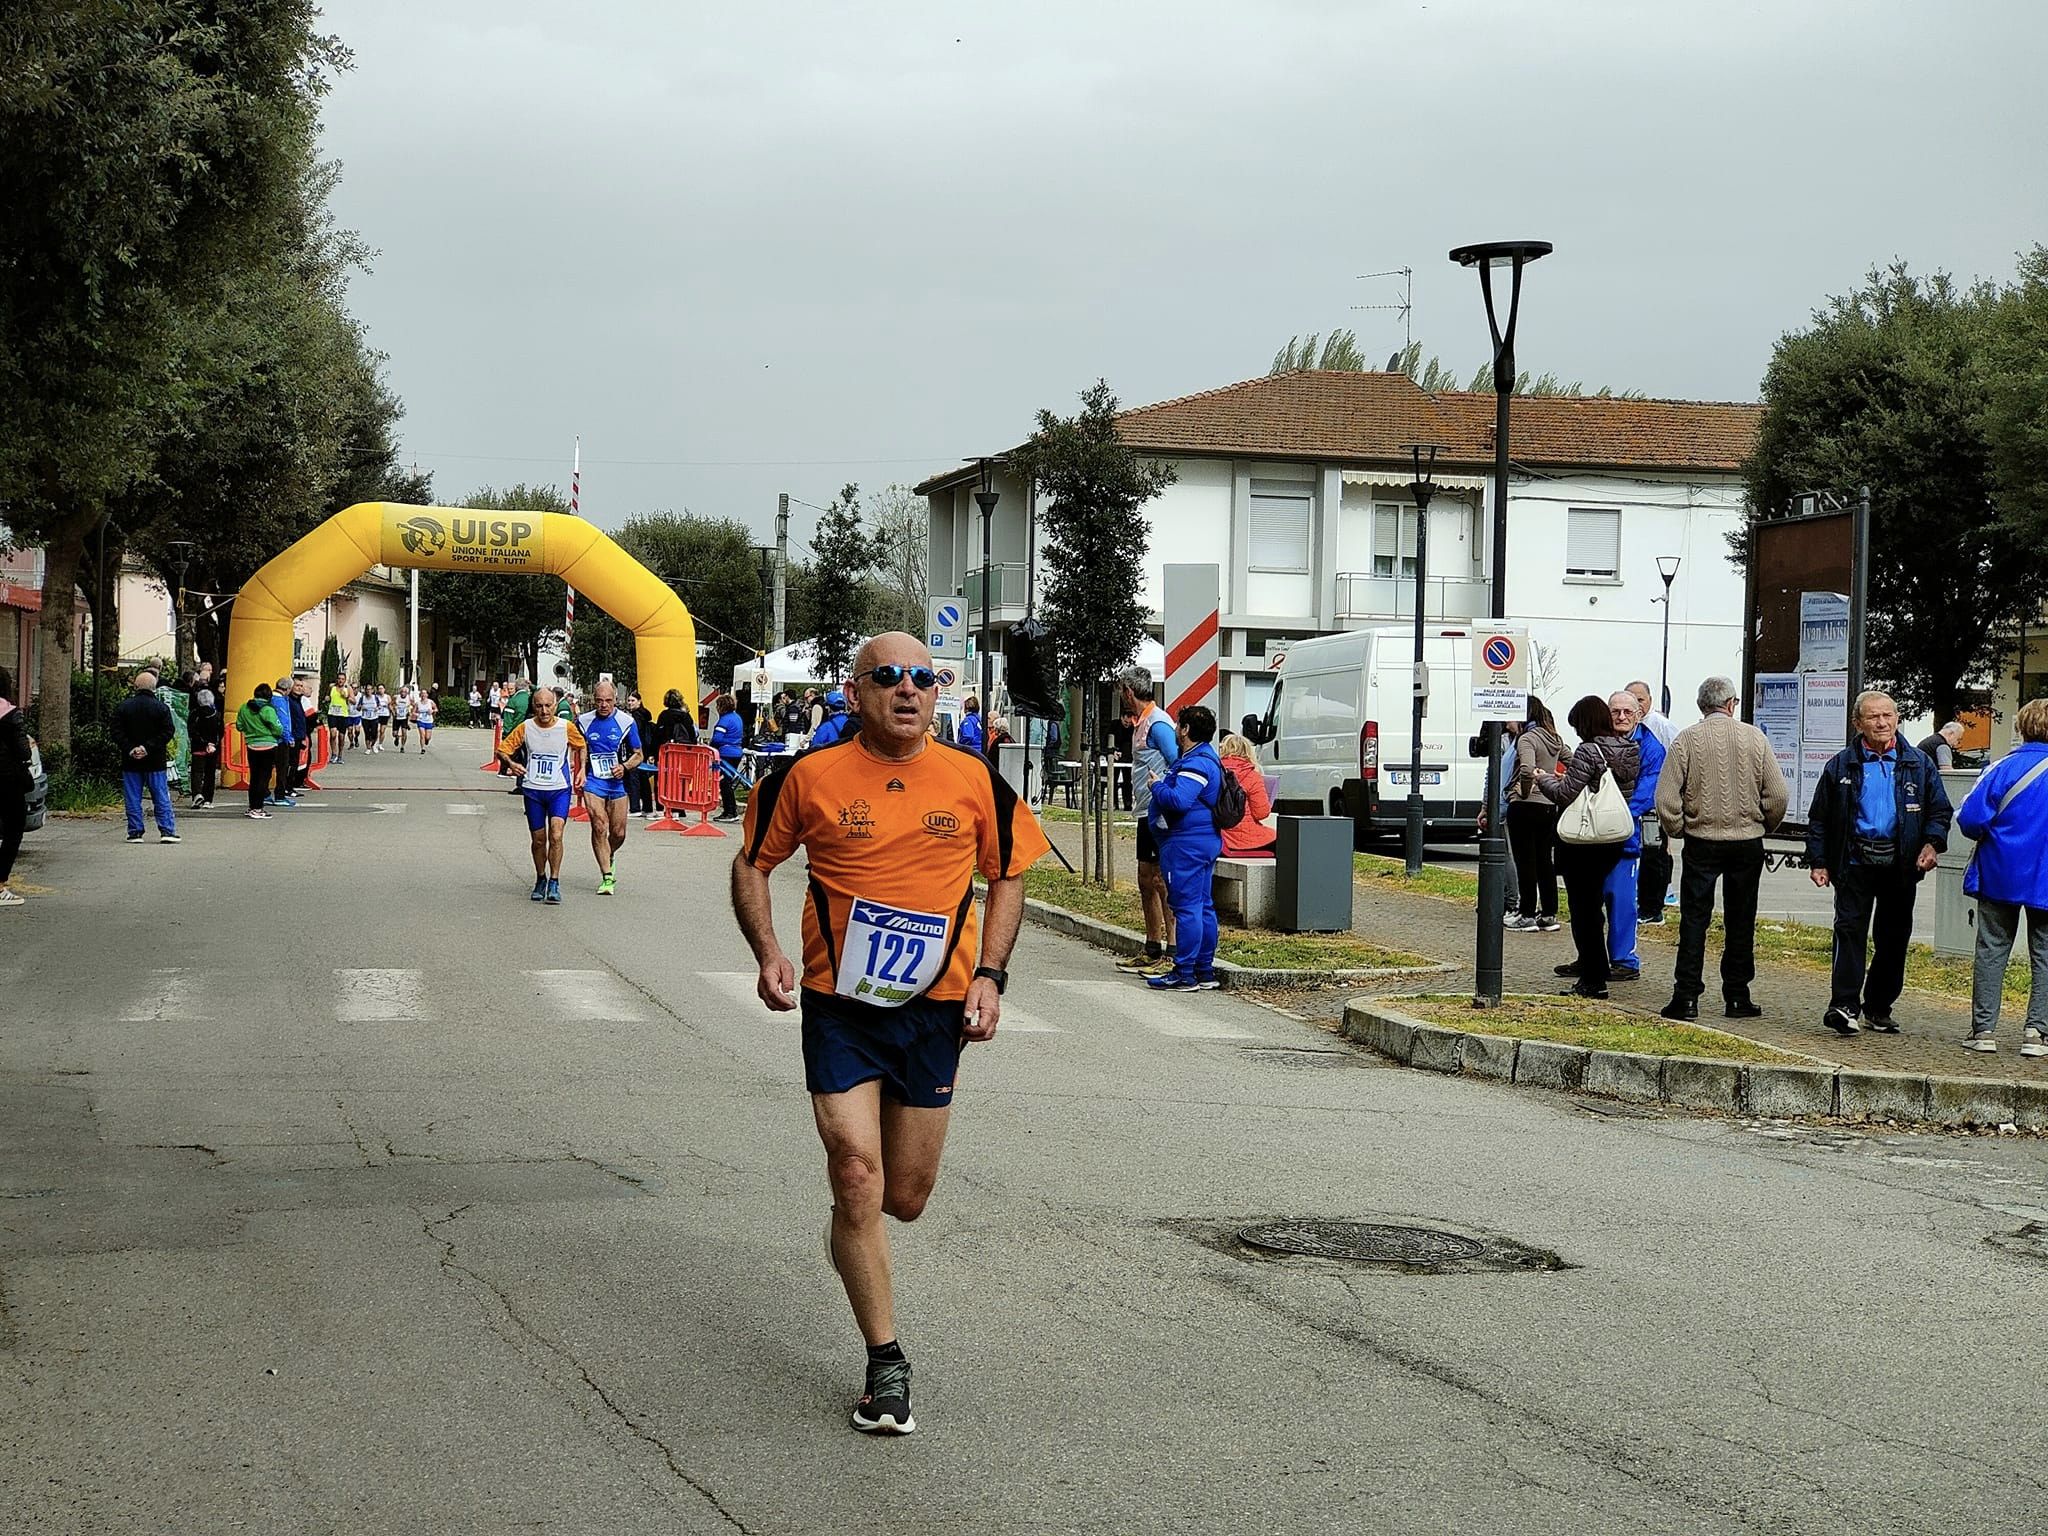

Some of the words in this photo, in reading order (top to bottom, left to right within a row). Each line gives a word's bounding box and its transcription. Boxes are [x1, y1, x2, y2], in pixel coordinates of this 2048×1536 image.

[452, 519, 532, 547] UISP
[451, 546, 487, 556] UNIONE
[491, 548, 531, 557] ITALIANA
[451, 555, 481, 563] SPORT
[504, 557, 526, 565] TUTTI
[1803, 622, 1821, 641] Ivan
[1823, 620, 1847, 641] Alvisi
[1807, 680, 1846, 688] RINGRAZIAMENTO
[537, 760, 553, 775] 104
[928, 815, 956, 829] LUCCI
[885, 916, 944, 936] MIZUNO
[865, 930, 926, 985] 122
